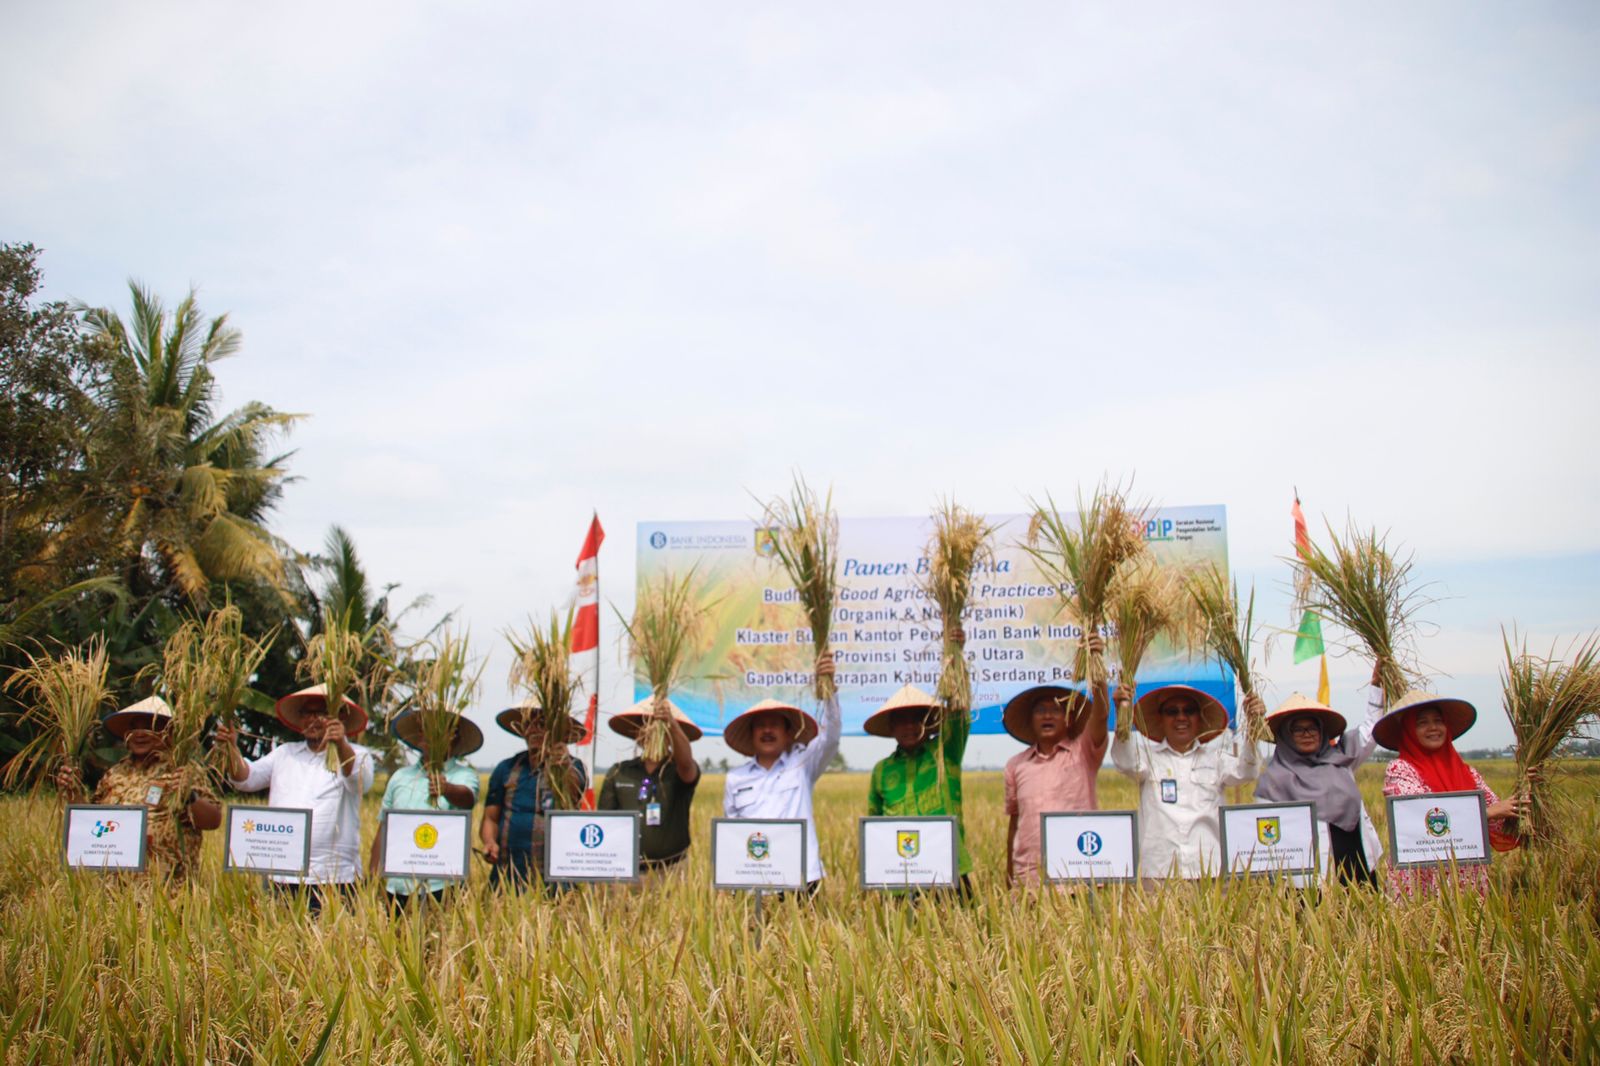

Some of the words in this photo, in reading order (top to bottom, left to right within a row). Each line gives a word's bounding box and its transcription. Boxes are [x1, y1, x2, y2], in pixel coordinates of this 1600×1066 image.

[843, 558, 907, 577] Panen
[840, 587, 879, 602] Good
[981, 584, 1054, 599] Practices
[833, 607, 898, 624] (Organik
[904, 608, 916, 620] &
[736, 629, 789, 643] Klaster
[854, 628, 903, 641] Kantor
[1003, 625, 1041, 640] Bank
[835, 649, 897, 663] Provinsi
[983, 647, 1024, 661] Utara
[835, 673, 888, 687] arapan
[982, 667, 1046, 684] Serdang
[256, 823, 295, 834] BULOG
